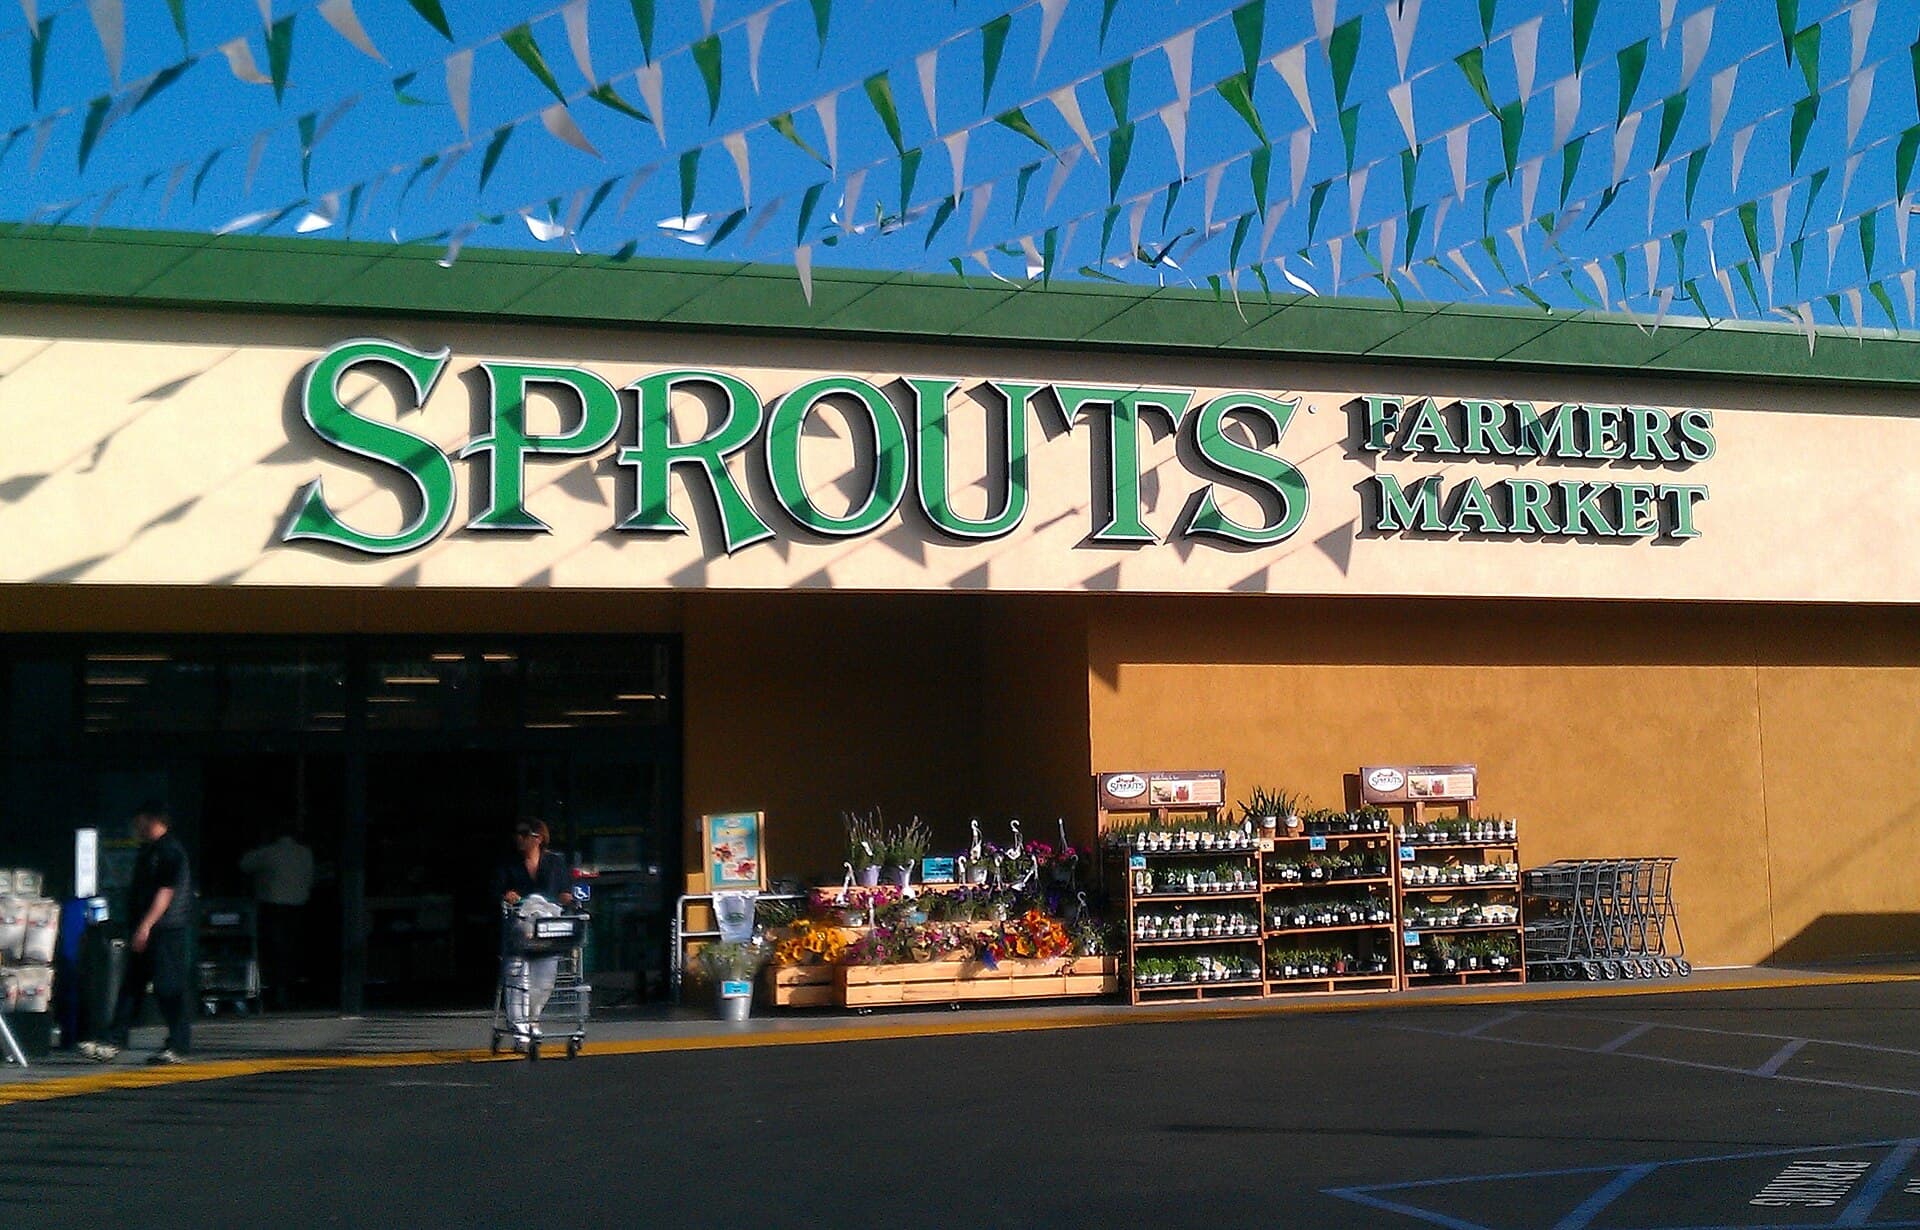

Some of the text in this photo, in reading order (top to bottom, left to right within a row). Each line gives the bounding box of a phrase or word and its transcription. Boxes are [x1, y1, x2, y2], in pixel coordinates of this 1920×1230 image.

[282, 336, 1310, 556] SPROUTS
[1362, 395, 1717, 464] FARMERS
[1376, 473, 1710, 541] MARKET
[1749, 1160, 1872, 1207] PARKING
